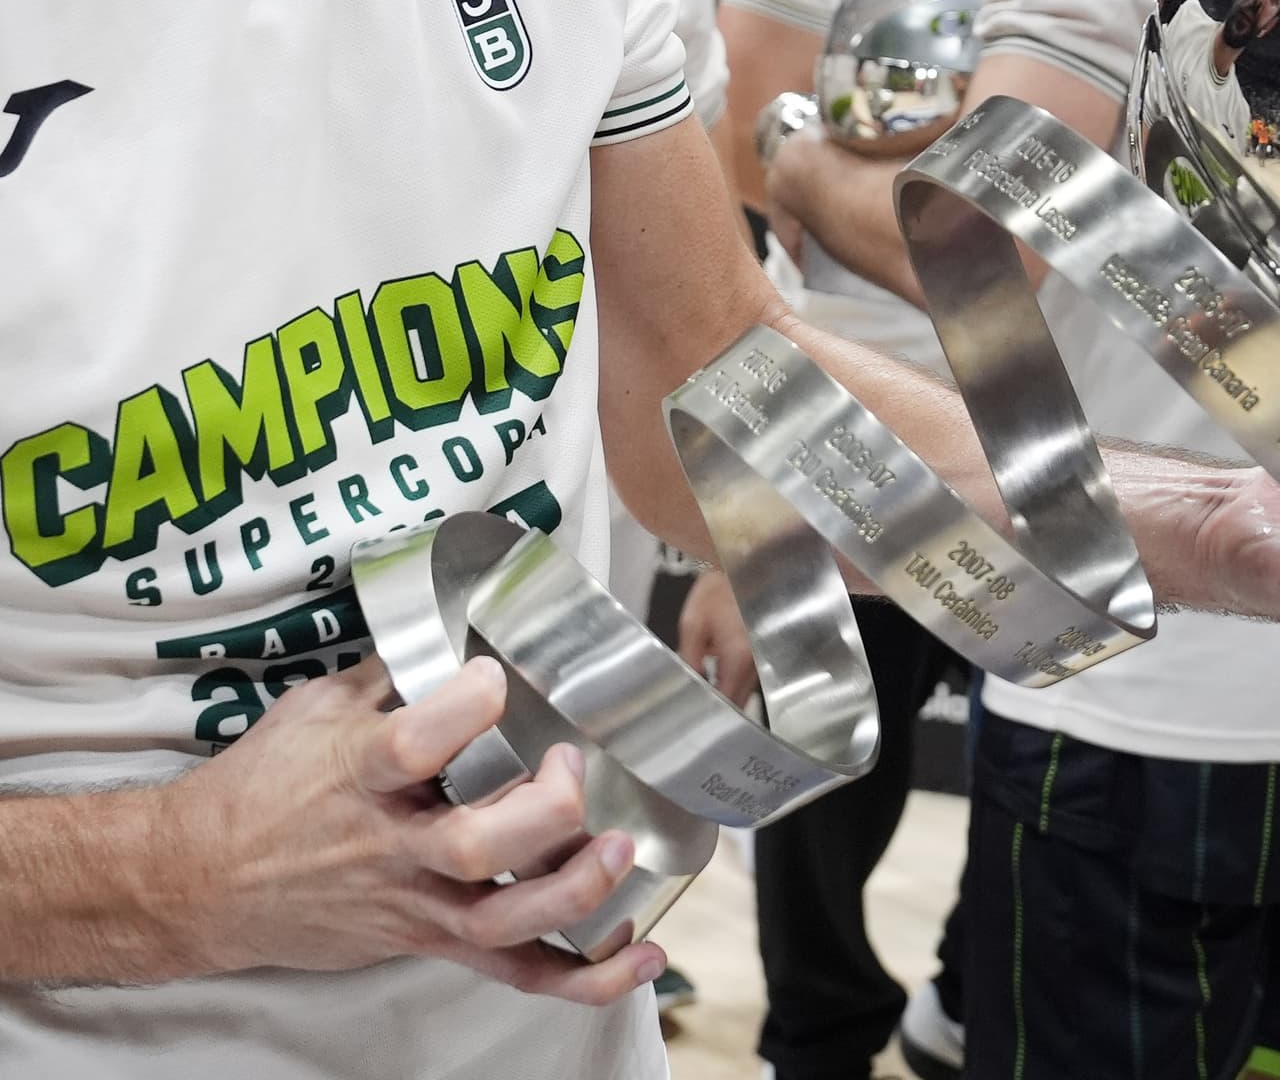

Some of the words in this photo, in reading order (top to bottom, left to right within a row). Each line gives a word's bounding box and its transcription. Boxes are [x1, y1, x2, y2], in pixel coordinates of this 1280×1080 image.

[1035, 196, 1076, 242] Lassa
[1198, 347, 1260, 412] Canaria
[125, 410, 547, 607] SUPERCOPA
[905, 552, 942, 590] TAU
[933, 579, 999, 640] Cerámica
[948, 540, 1016, 601] 2007-08
